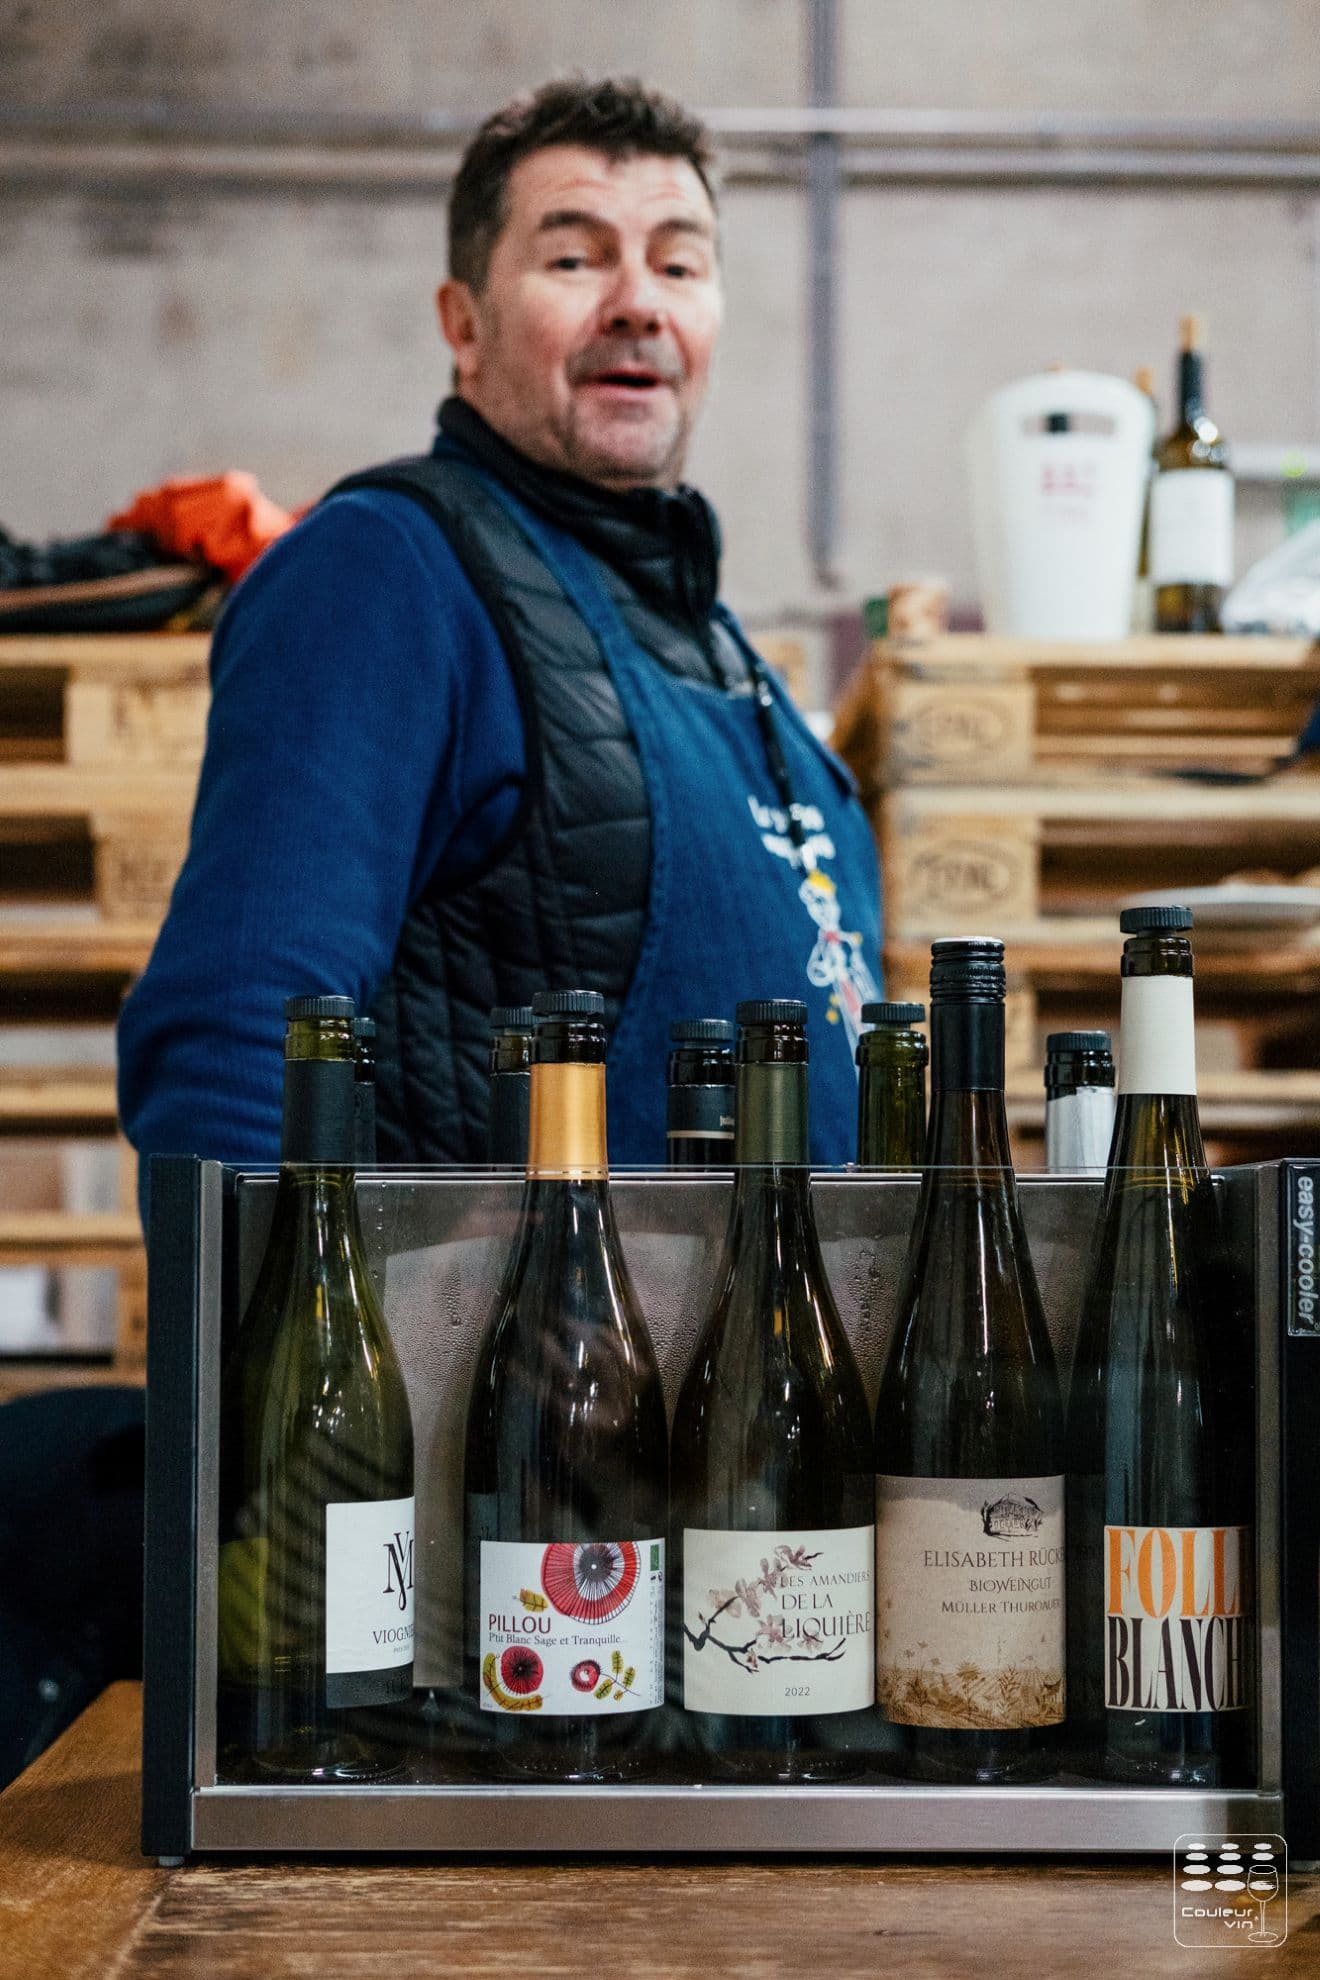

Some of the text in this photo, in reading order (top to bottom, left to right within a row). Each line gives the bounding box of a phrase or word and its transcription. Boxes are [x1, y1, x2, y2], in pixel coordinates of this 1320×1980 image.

[1293, 1176, 1320, 1325] easy-cooler
[924, 1550, 1024, 1568] ELISABETH
[780, 1575, 804, 1588] LES
[970, 1576, 1052, 1594] BIOWEINGUT
[781, 1593, 834, 1610] DE LA
[941, 1600, 996, 1614] MÜLLER
[488, 1613, 551, 1634] PILLOU
[781, 1610, 872, 1643] LIQUIÈRE
[506, 1634, 531, 1645] Blanc
[534, 1635, 557, 1648] Sage
[559, 1637, 569, 1646] et
[571, 1634, 621, 1648] Tranquille
[784, 1686, 811, 1697] 2022
